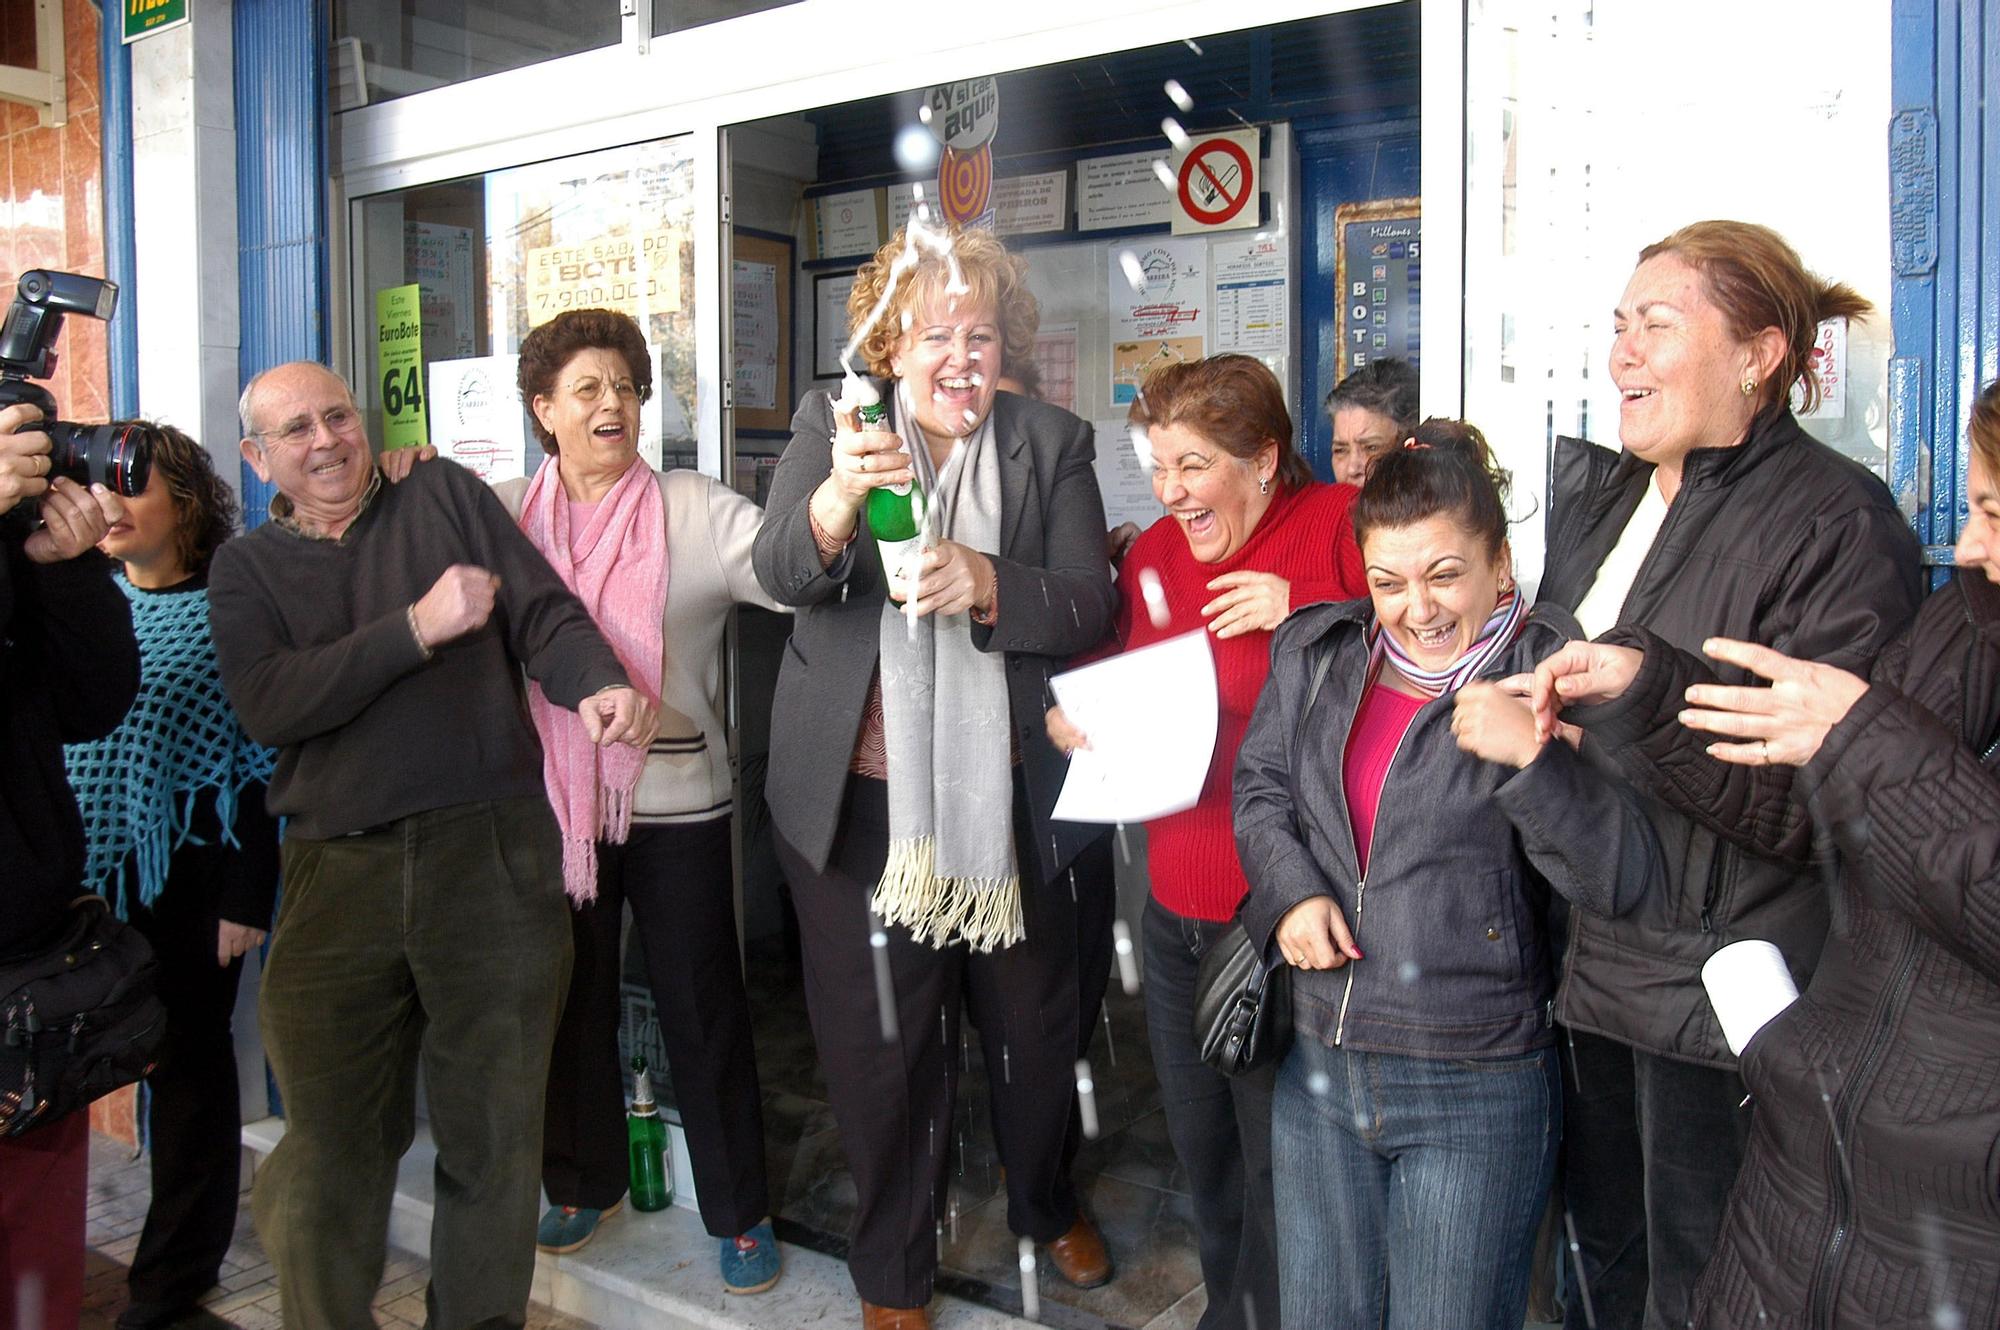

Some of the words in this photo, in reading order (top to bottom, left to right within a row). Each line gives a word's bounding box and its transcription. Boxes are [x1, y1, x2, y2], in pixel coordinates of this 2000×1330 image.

[999, 196, 1048, 209] PERROS
[1370, 226, 1411, 238] Millones
[540, 248, 586, 266] ESTE
[1408, 242, 1419, 257] 5
[559, 255, 637, 281] BOTE
[391, 295, 405, 306] Este
[386, 309, 412, 319] Viernes
[379, 321, 419, 343] EuroBote
[1352, 281, 1367, 367] BOTE
[382, 365, 422, 417] 64
